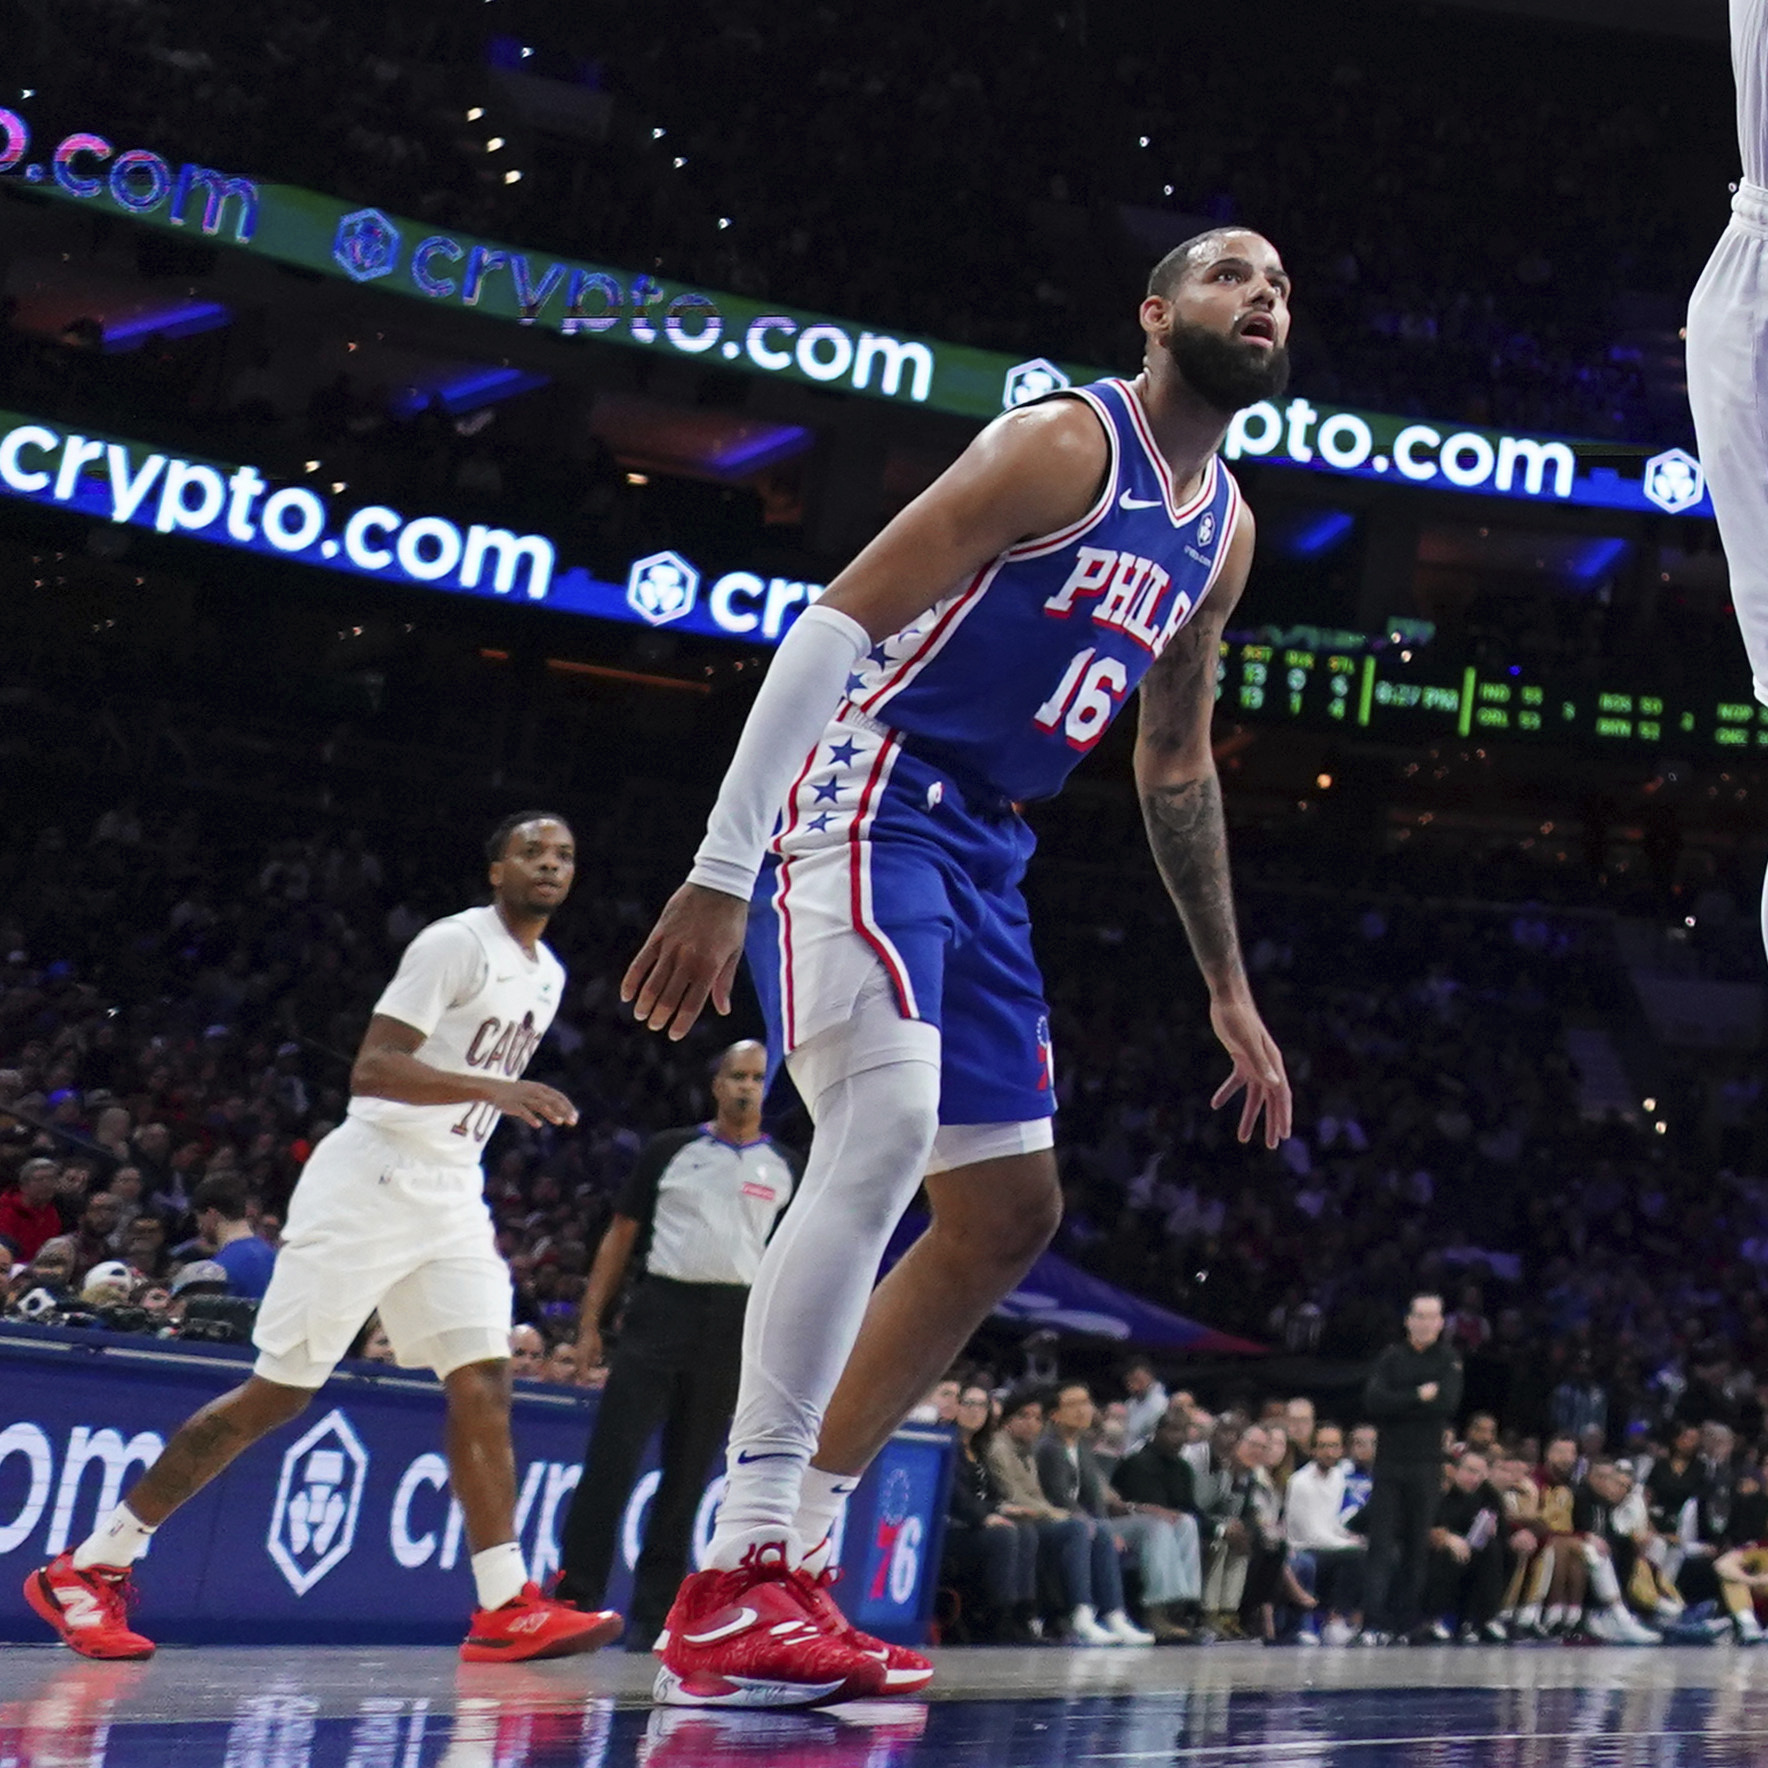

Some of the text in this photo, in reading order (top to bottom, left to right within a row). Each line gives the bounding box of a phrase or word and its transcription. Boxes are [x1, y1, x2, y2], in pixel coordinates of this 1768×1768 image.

[410, 234, 935, 402] crypto.com
[0, 426, 556, 600] crypto.com
[1034, 644, 1128, 753] 16
